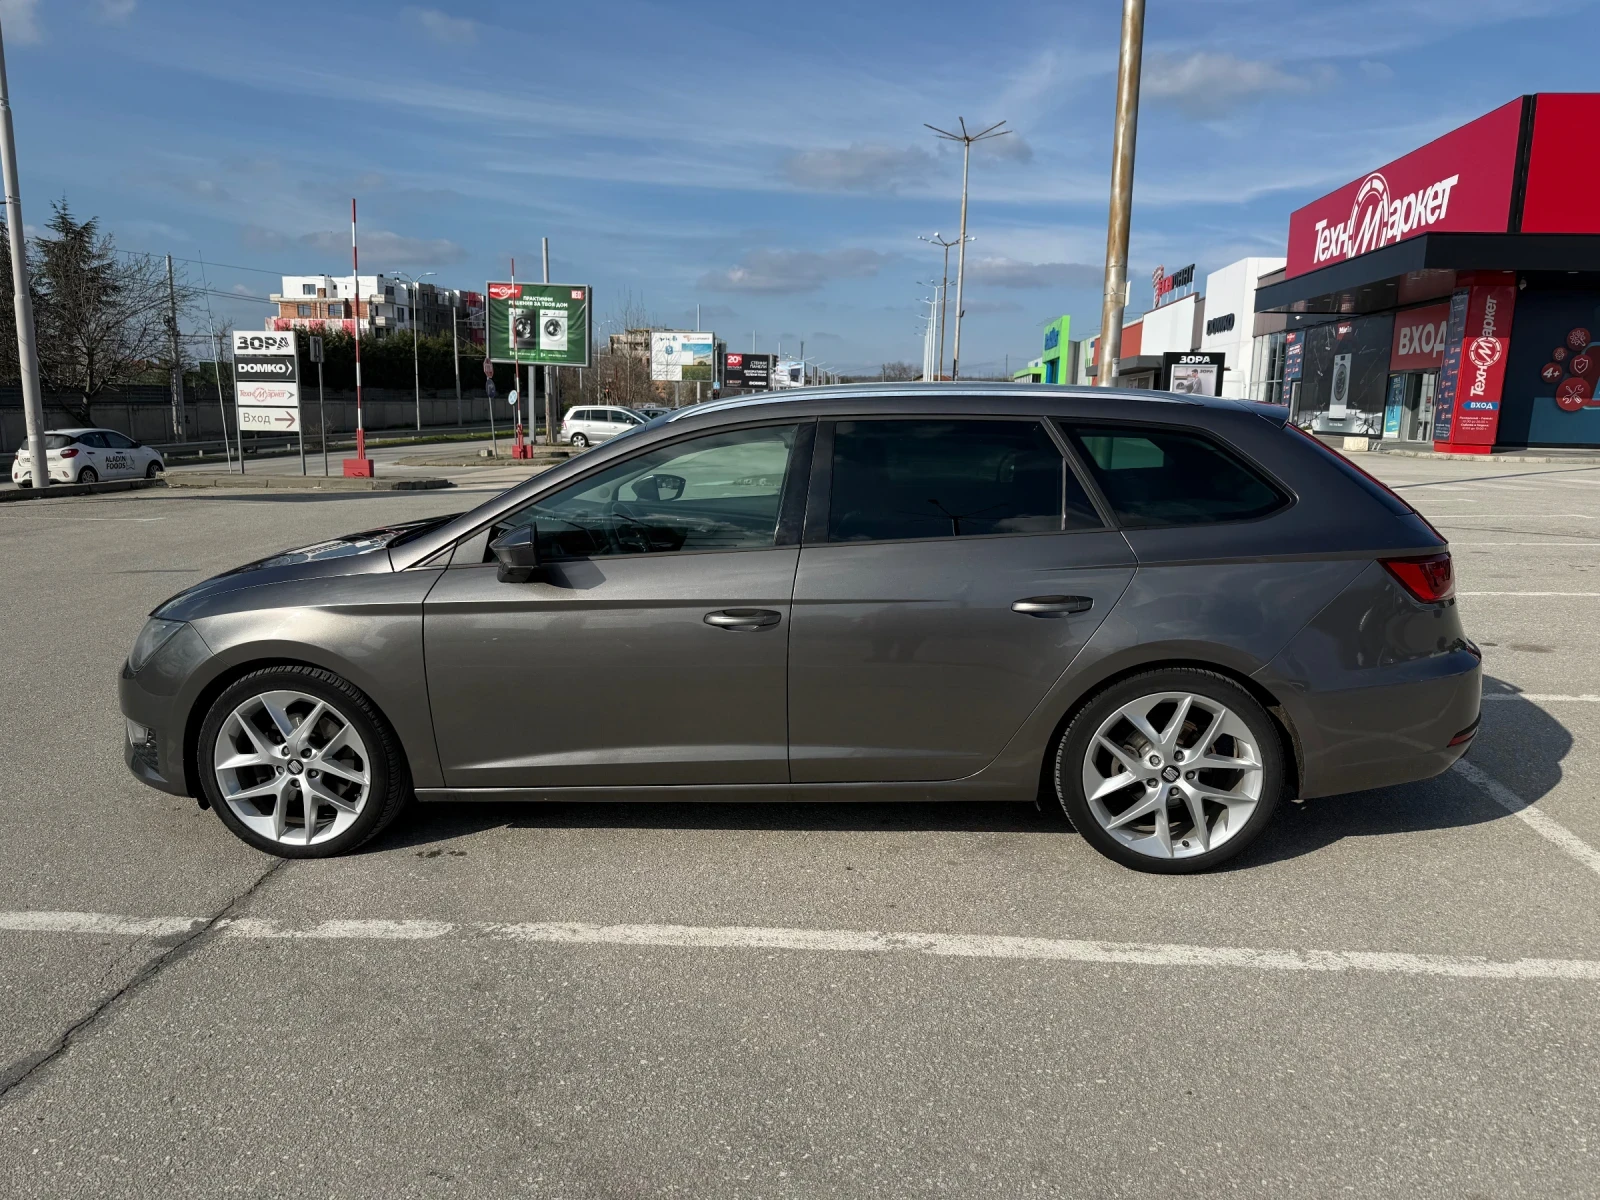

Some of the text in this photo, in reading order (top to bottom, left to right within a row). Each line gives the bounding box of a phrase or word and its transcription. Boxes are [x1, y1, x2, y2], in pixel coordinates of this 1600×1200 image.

[237, 336, 290, 351] ЗОРА
[727, 355, 742, 363] 20%
[1179, 355, 1211, 364] ЗОРА
[237, 363, 286, 373] DOMKO
[1542, 367, 1560, 378] 4+
[1470, 402, 1493, 410] ВХОД
[243, 412, 271, 425] Вход
[105, 455, 126, 463] ALADIN
[106, 462, 126, 470] FOODS
